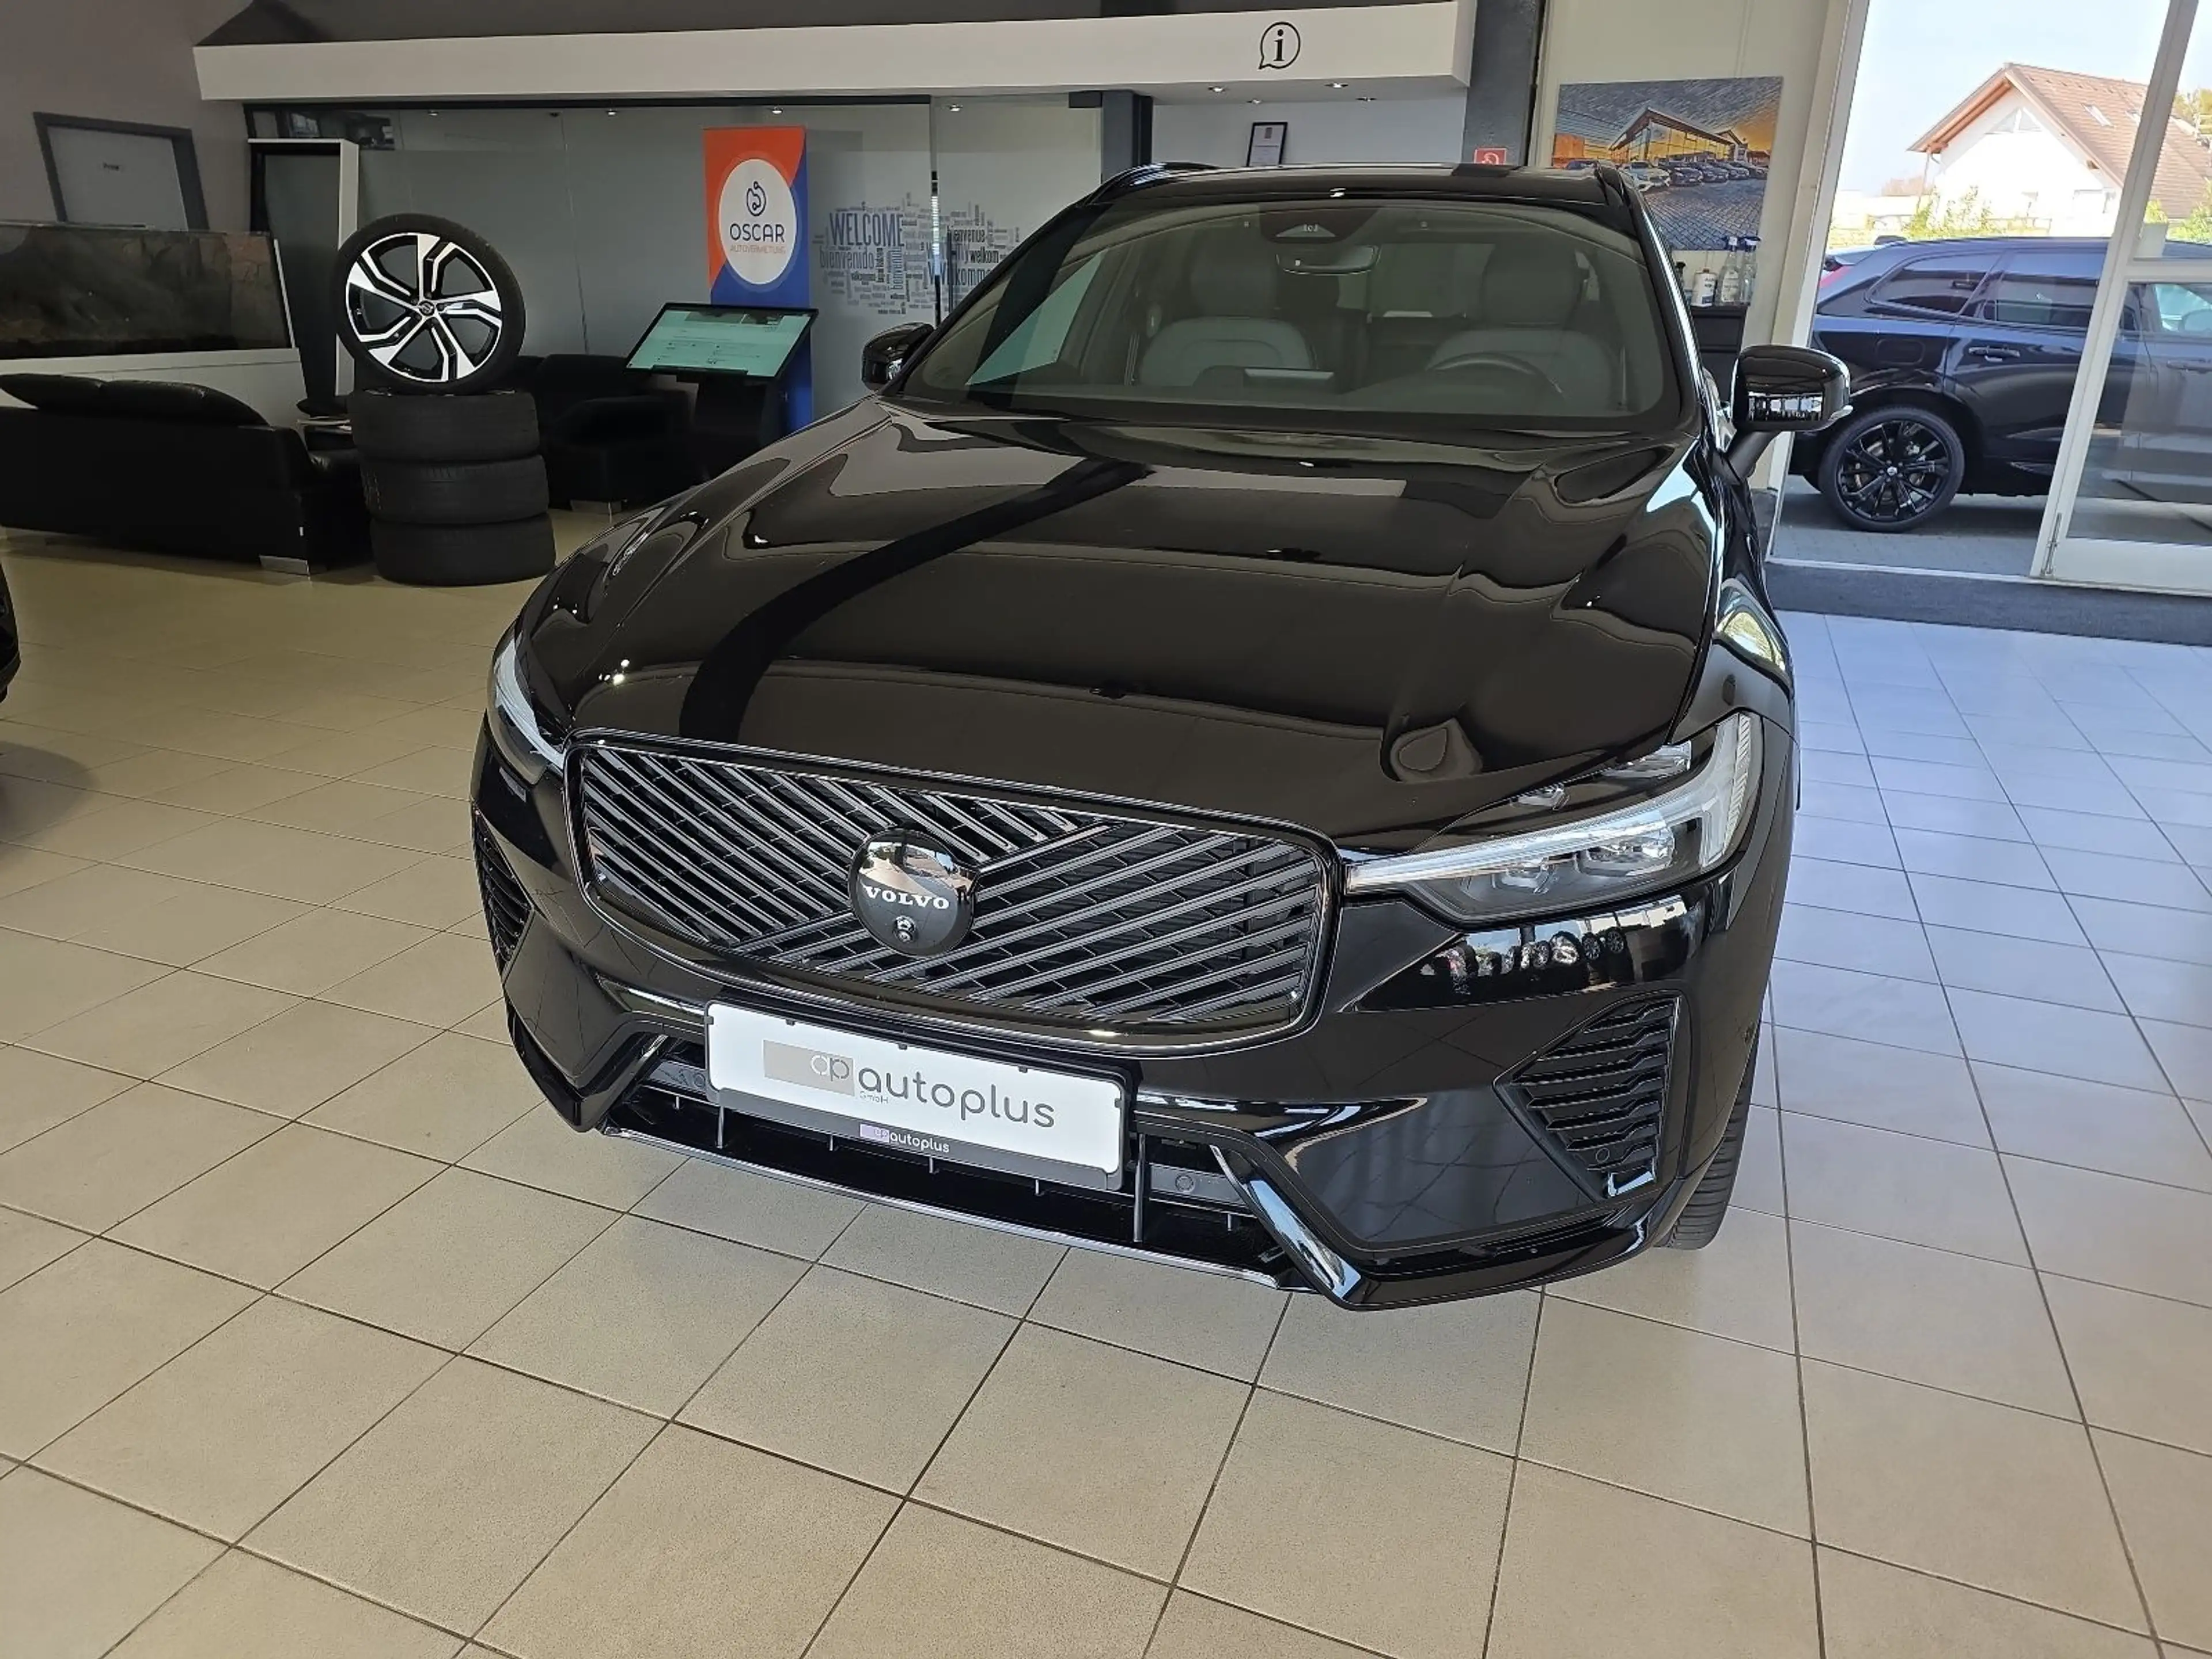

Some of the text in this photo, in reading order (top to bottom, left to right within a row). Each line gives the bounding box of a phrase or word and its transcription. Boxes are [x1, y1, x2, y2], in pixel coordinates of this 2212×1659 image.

[729, 222, 785, 243] OSCAR
[830, 213, 905, 247] WELCOME
[865, 885, 950, 910] VOLVO
[858, 1067, 1055, 1128] autoplus
[890, 1132, 950, 1153] autoplus
